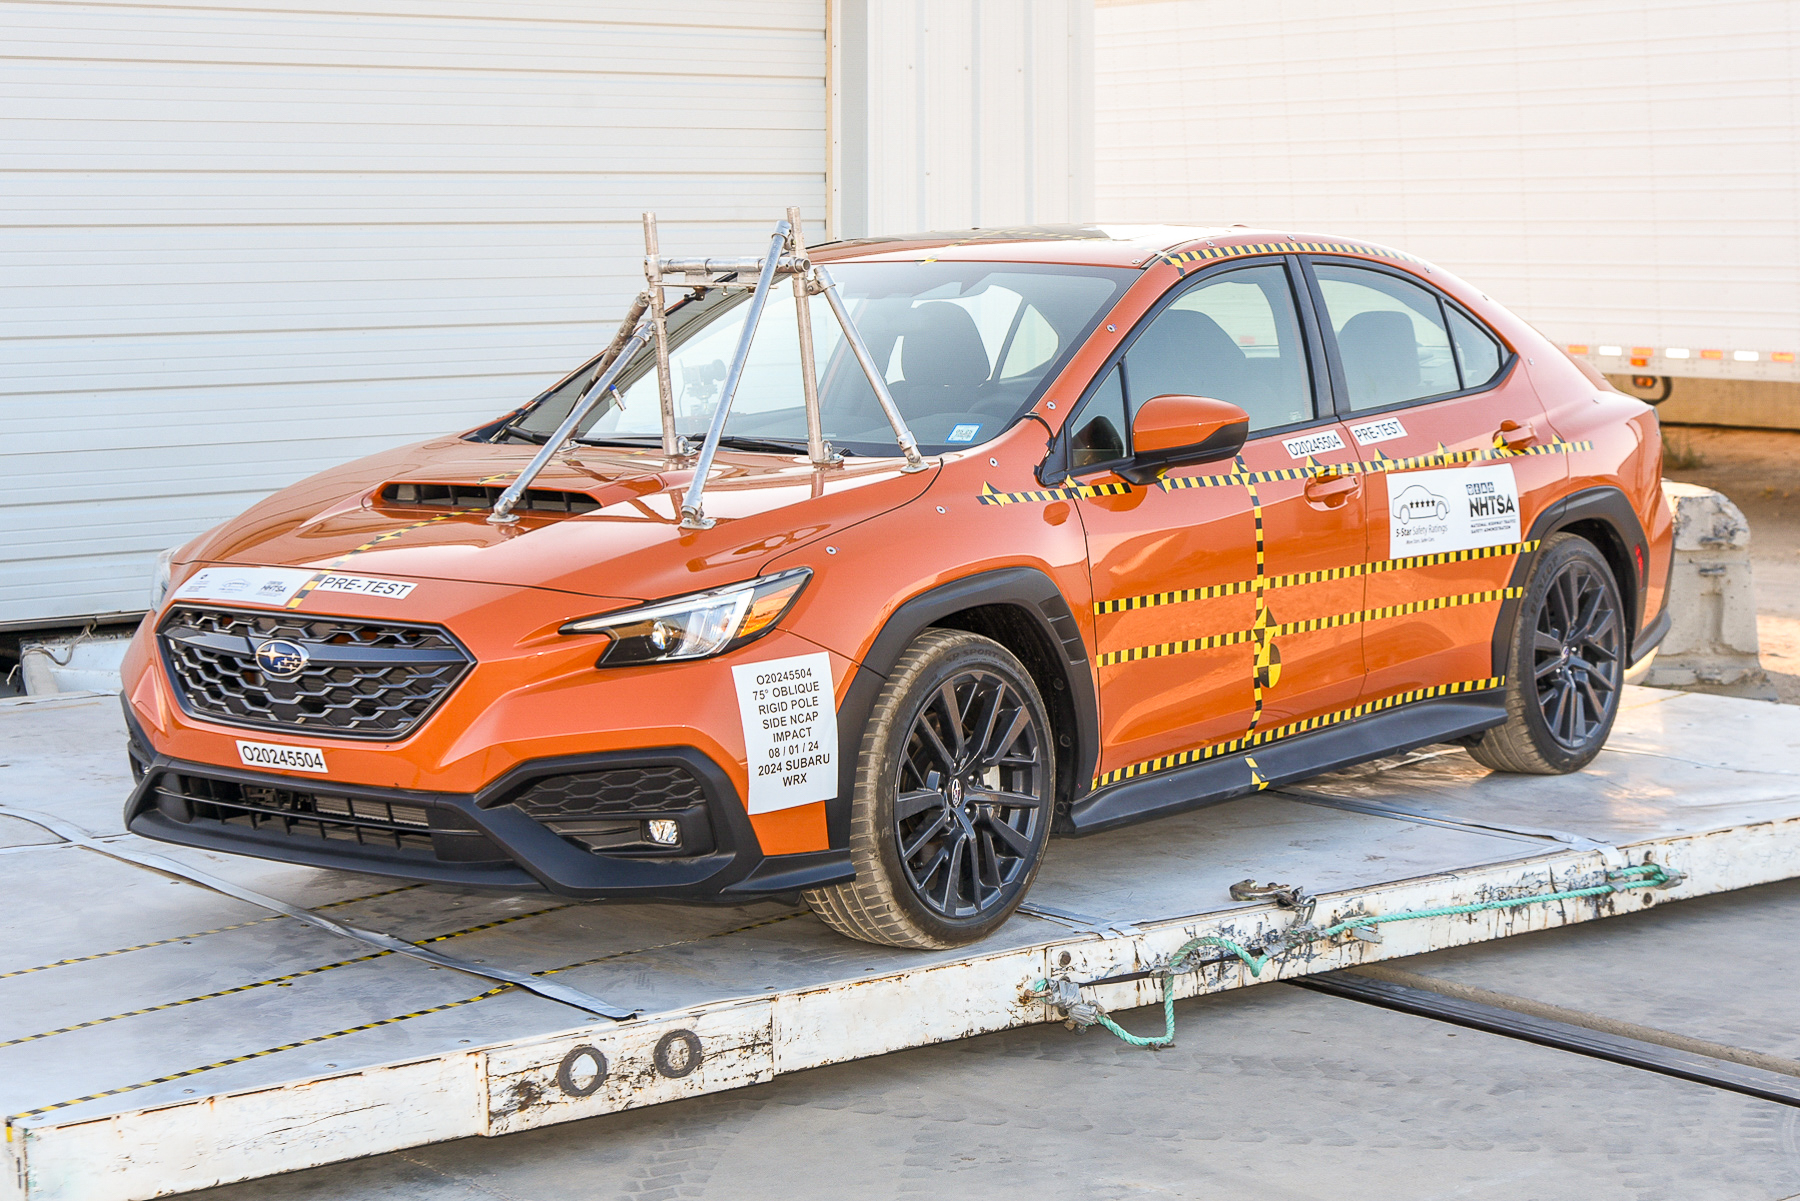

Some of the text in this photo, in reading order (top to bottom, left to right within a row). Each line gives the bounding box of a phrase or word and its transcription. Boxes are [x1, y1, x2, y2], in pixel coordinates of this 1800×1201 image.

[1354, 421, 1403, 442] PRE-TEST
[1469, 494, 1516, 518] NHTSA
[1396, 523, 1448, 538] 5-Star Safety Ratings
[320, 576, 411, 596] PRE-TEST
[963, 648, 999, 659] SPORT
[753, 681, 820, 701] 75° OBLIQUE
[758, 696, 819, 715] RIGID POLE
[762, 711, 819, 730] SIDE NCAP
[773, 727, 812, 743] IMPACT
[768, 747, 780, 759] 08
[788, 744, 799, 756] 01
[808, 740, 819, 752] 24
[758, 753, 830, 777] 2024 SUBARU
[782, 772, 807, 787] WRX
